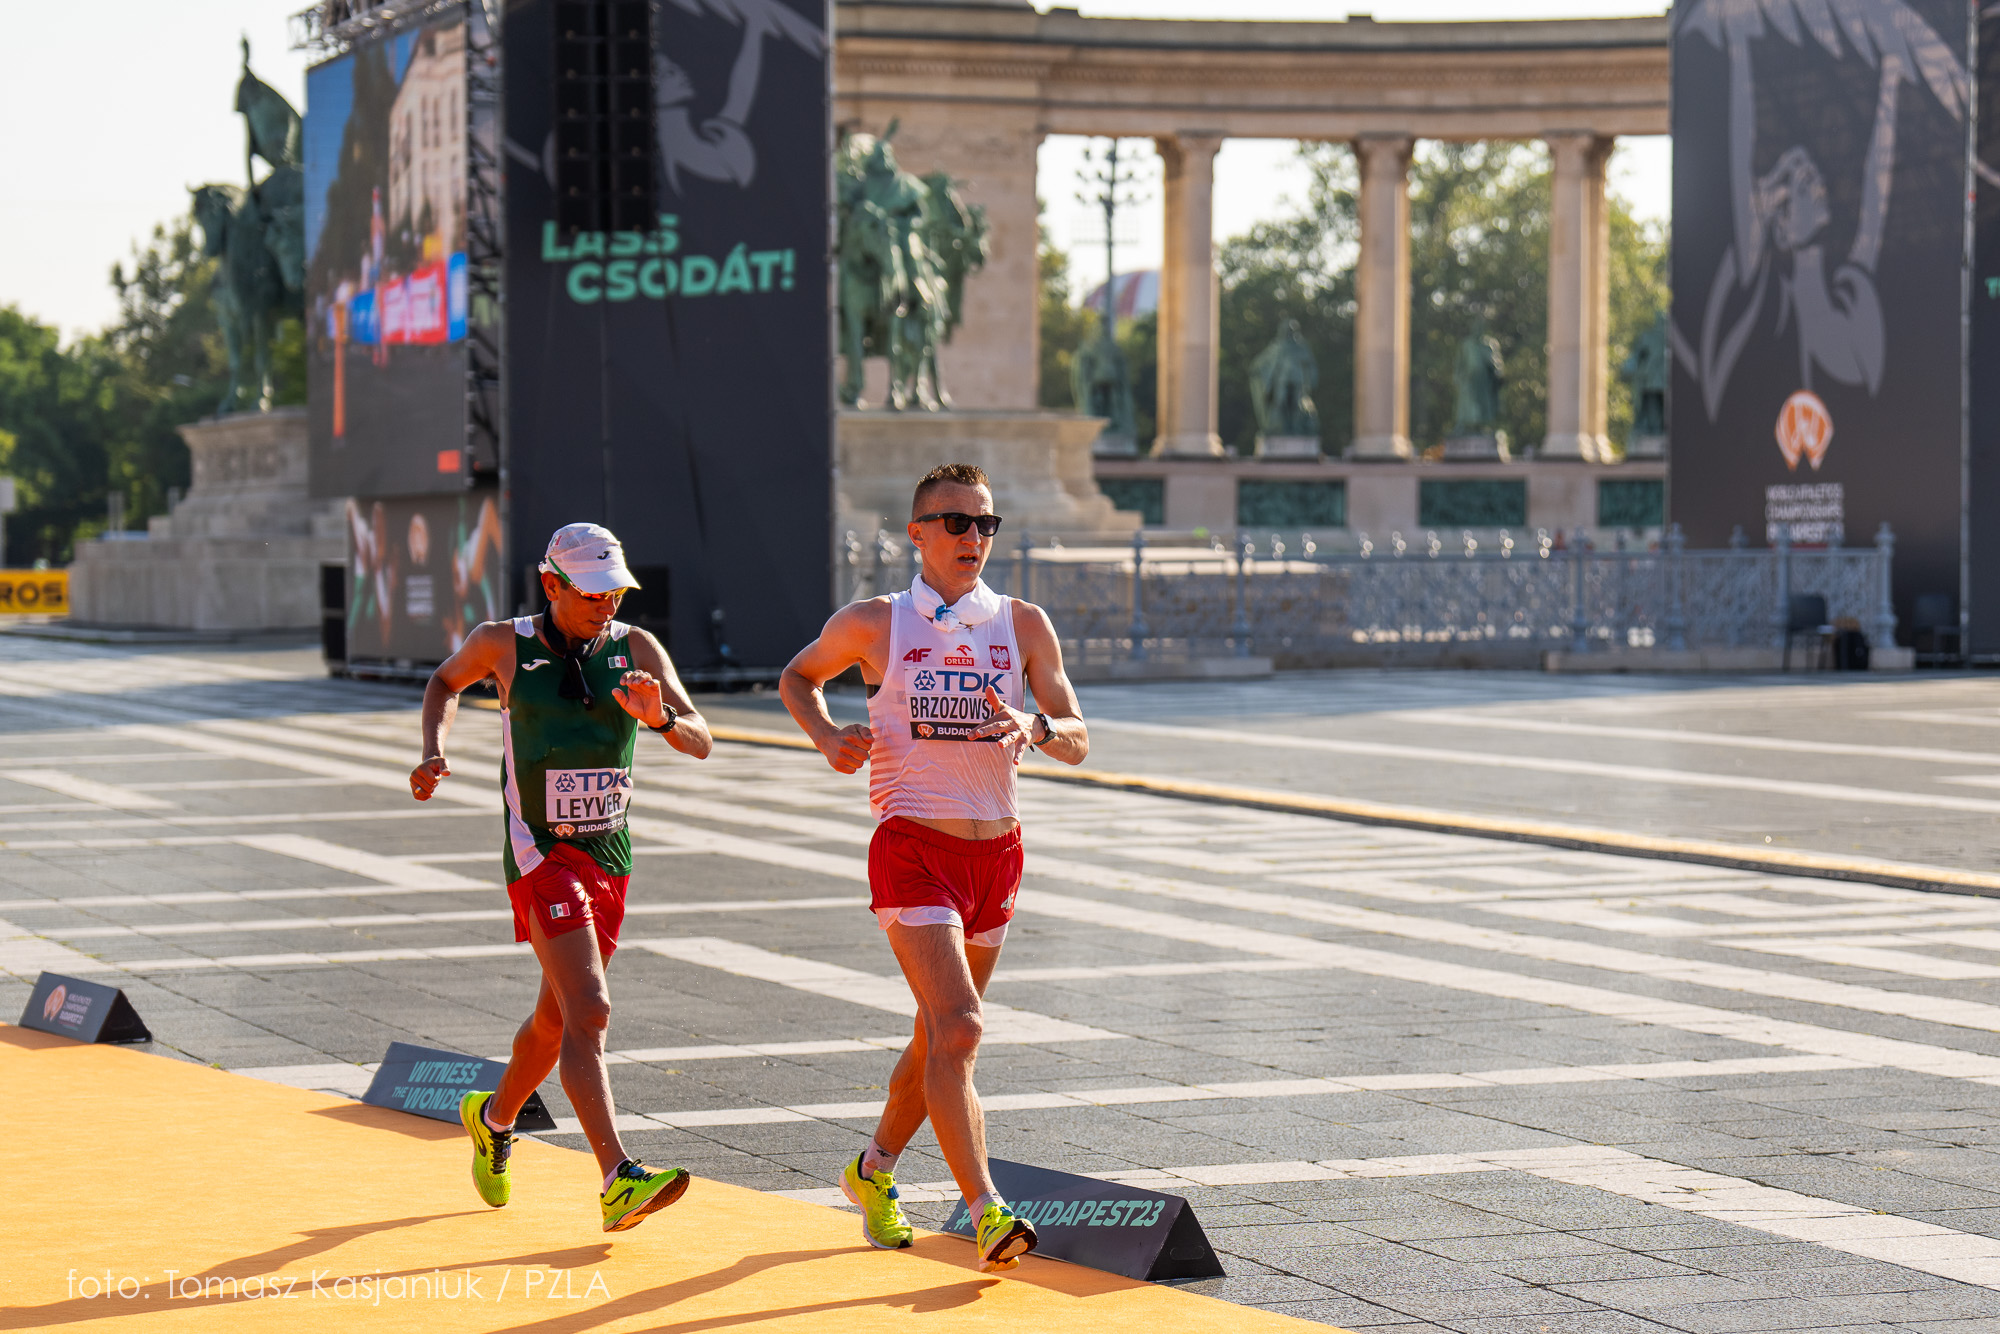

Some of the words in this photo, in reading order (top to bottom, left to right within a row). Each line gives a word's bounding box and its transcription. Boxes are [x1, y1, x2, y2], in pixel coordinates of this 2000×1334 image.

[566, 242, 796, 304] CSODÁT!
[946, 658, 973, 666] ORLEN
[936, 670, 1005, 695] TDK
[910, 696, 1006, 720] BRZOZOWS
[575, 771, 629, 792] TDK
[556, 792, 622, 819] LEYVER
[577, 820, 617, 833] BUDAPEST
[408, 1060, 483, 1085] WITNESS
[392, 1086, 409, 1098] THE
[403, 1087, 476, 1111] WONDE
